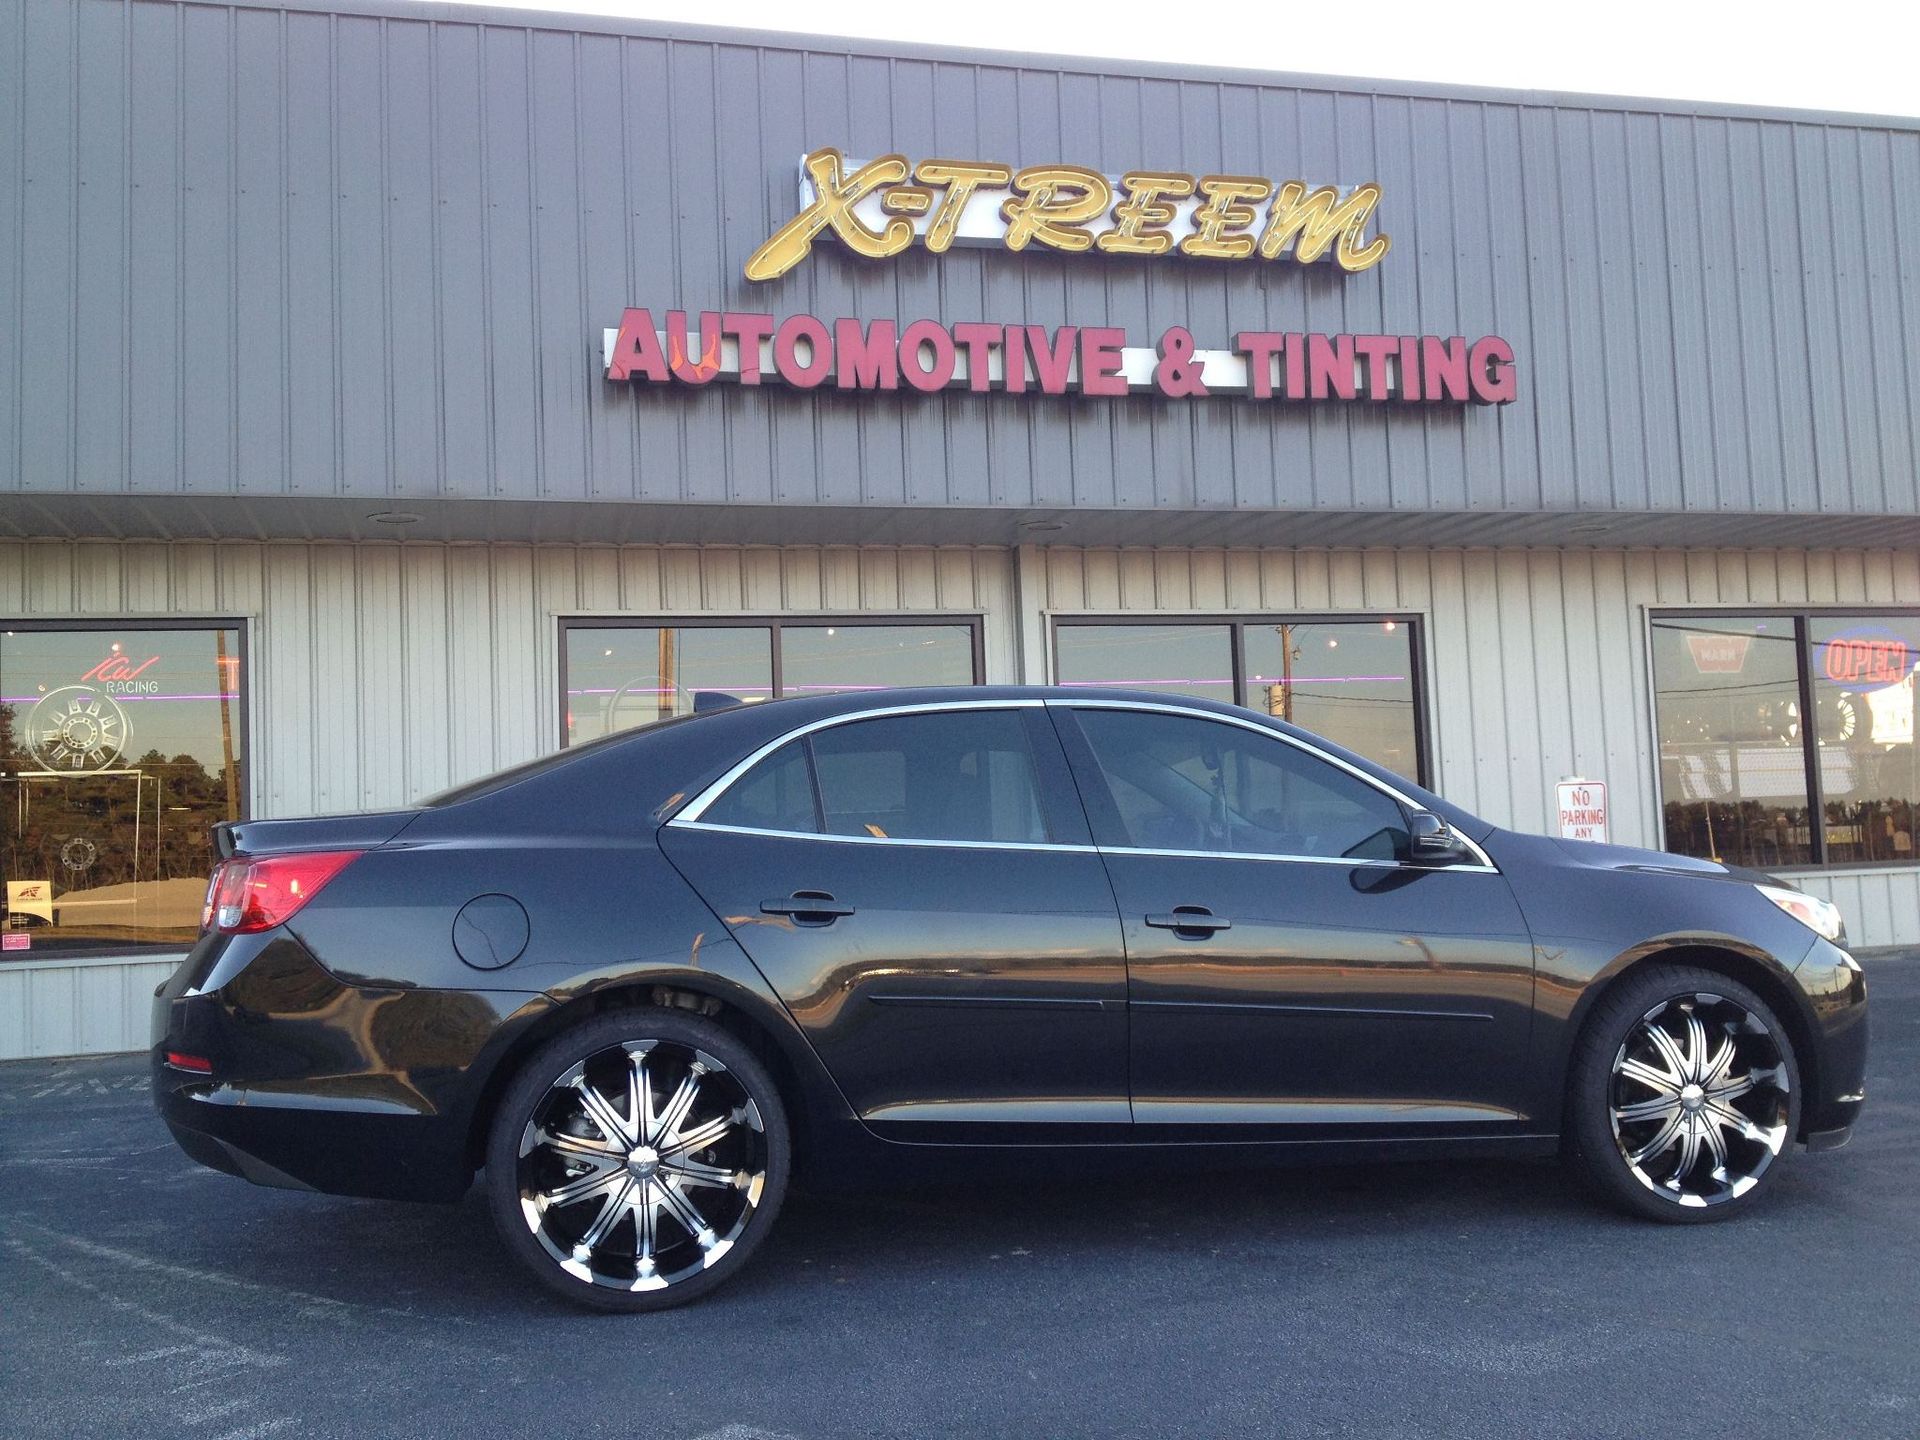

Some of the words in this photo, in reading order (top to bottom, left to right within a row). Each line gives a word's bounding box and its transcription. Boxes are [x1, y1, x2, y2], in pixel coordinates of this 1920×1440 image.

[744, 146, 1391, 282] X-TREEM
[607, 306, 1130, 397] AUTOMOTIVE
[1153, 325, 1210, 399] &
[1234, 330, 1518, 404] TINTING
[1826, 639, 1906, 682] OPEN
[106, 681, 159, 694] RACING
[1571, 790, 1591, 806] NO
[1561, 808, 1604, 826] PARKING
[1575, 827, 1593, 838] ANY
